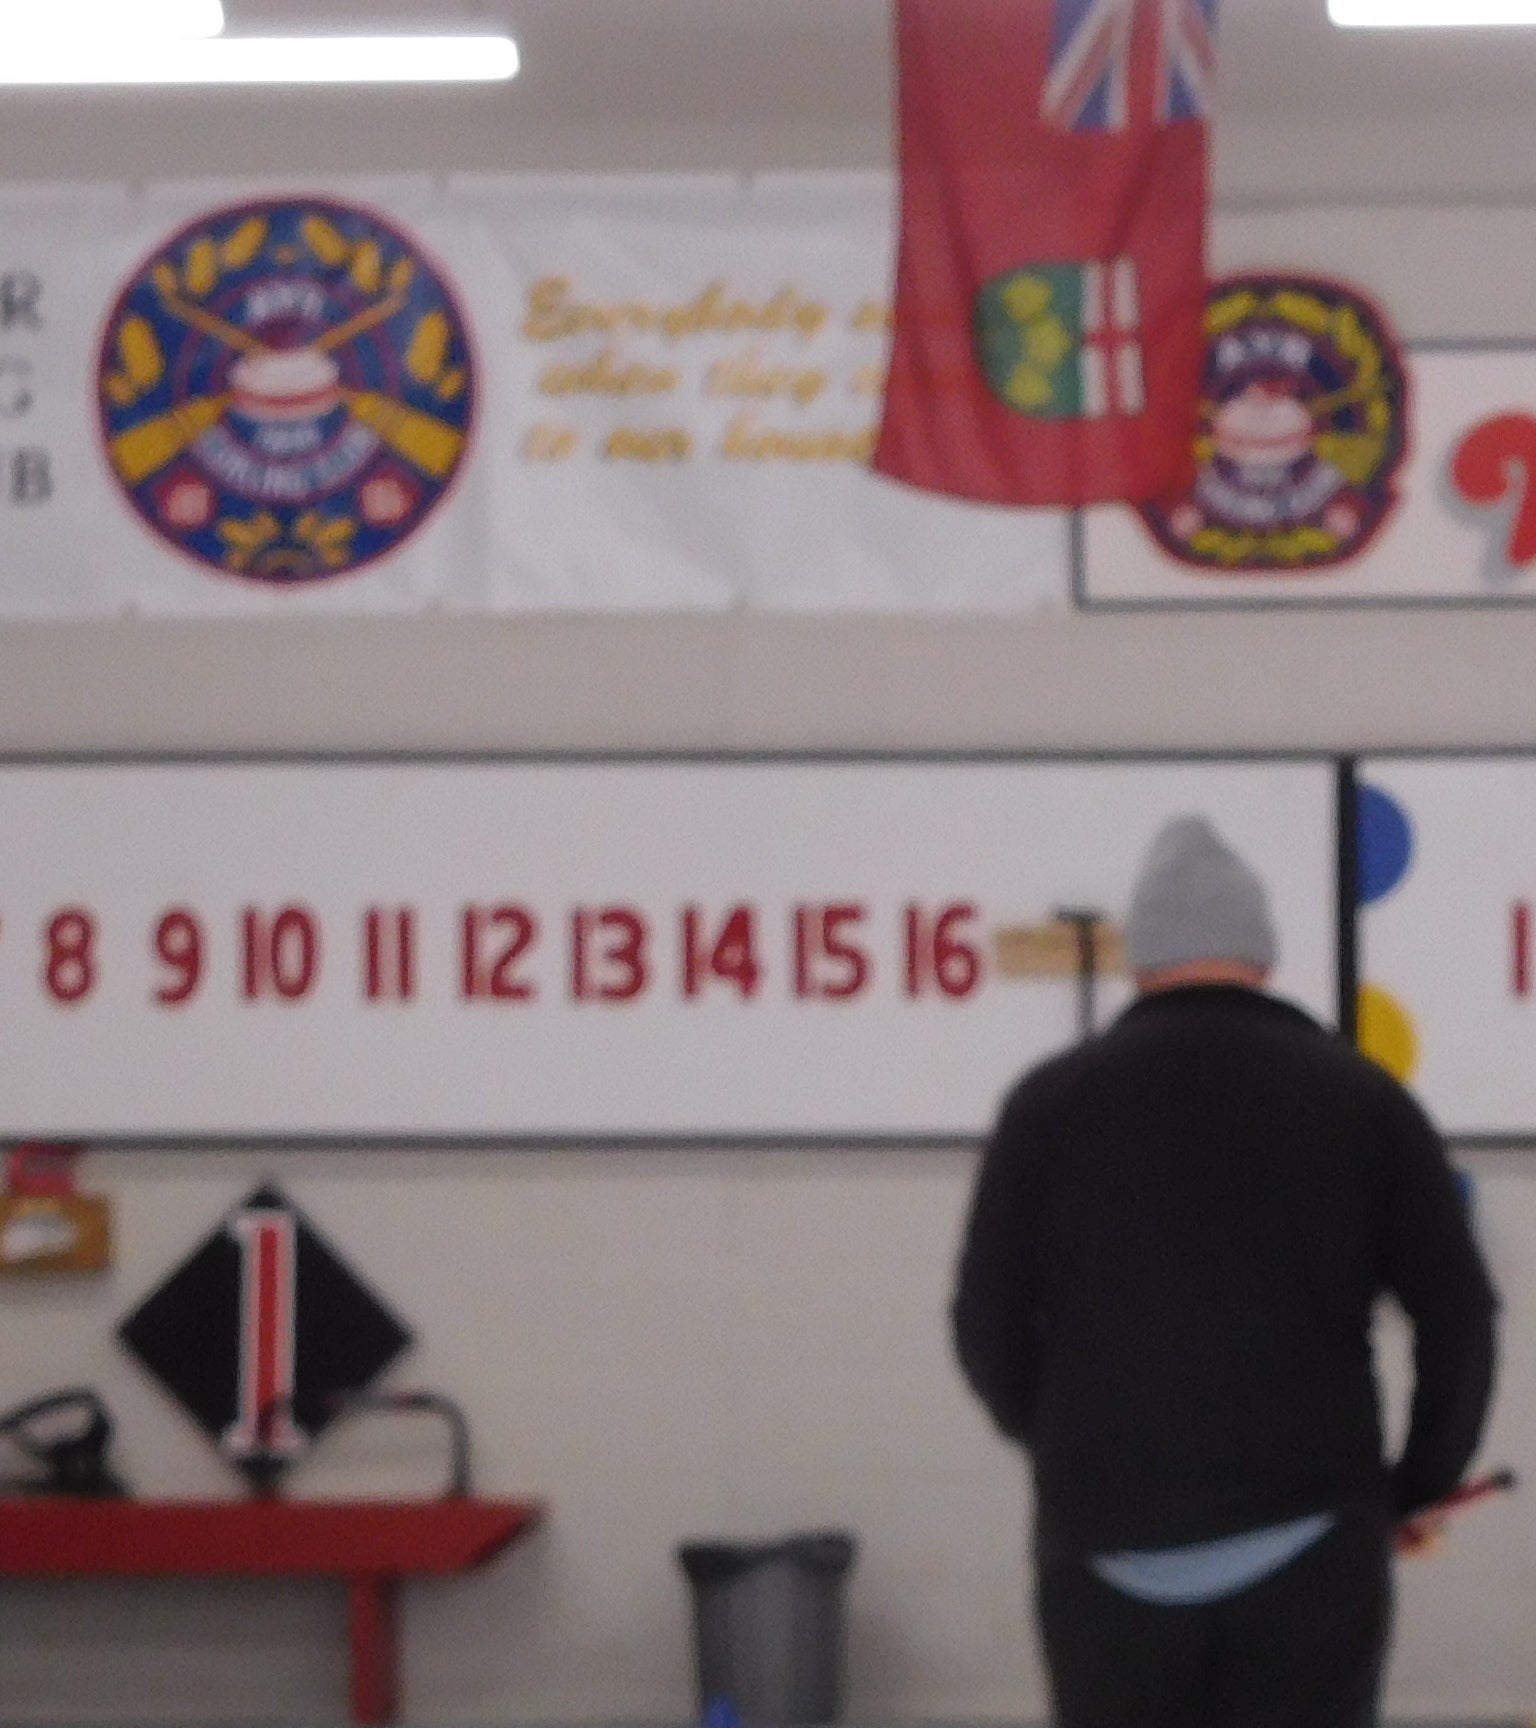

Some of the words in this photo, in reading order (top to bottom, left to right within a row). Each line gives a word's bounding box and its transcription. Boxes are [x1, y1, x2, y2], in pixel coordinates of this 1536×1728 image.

[44, 910, 97, 1004] 8
[155, 909, 205, 1006] 9
[241, 907, 318, 1000] 10
[364, 909, 417, 1001] 11
[462, 906, 537, 1002] 12
[572, 908, 650, 1002] 13
[681, 905, 762, 999] 14
[794, 904, 868, 1000] 15
[905, 905, 982, 1000] 16
[1509, 900, 1534, 998] 1
[227, 1210, 304, 1456] 1
